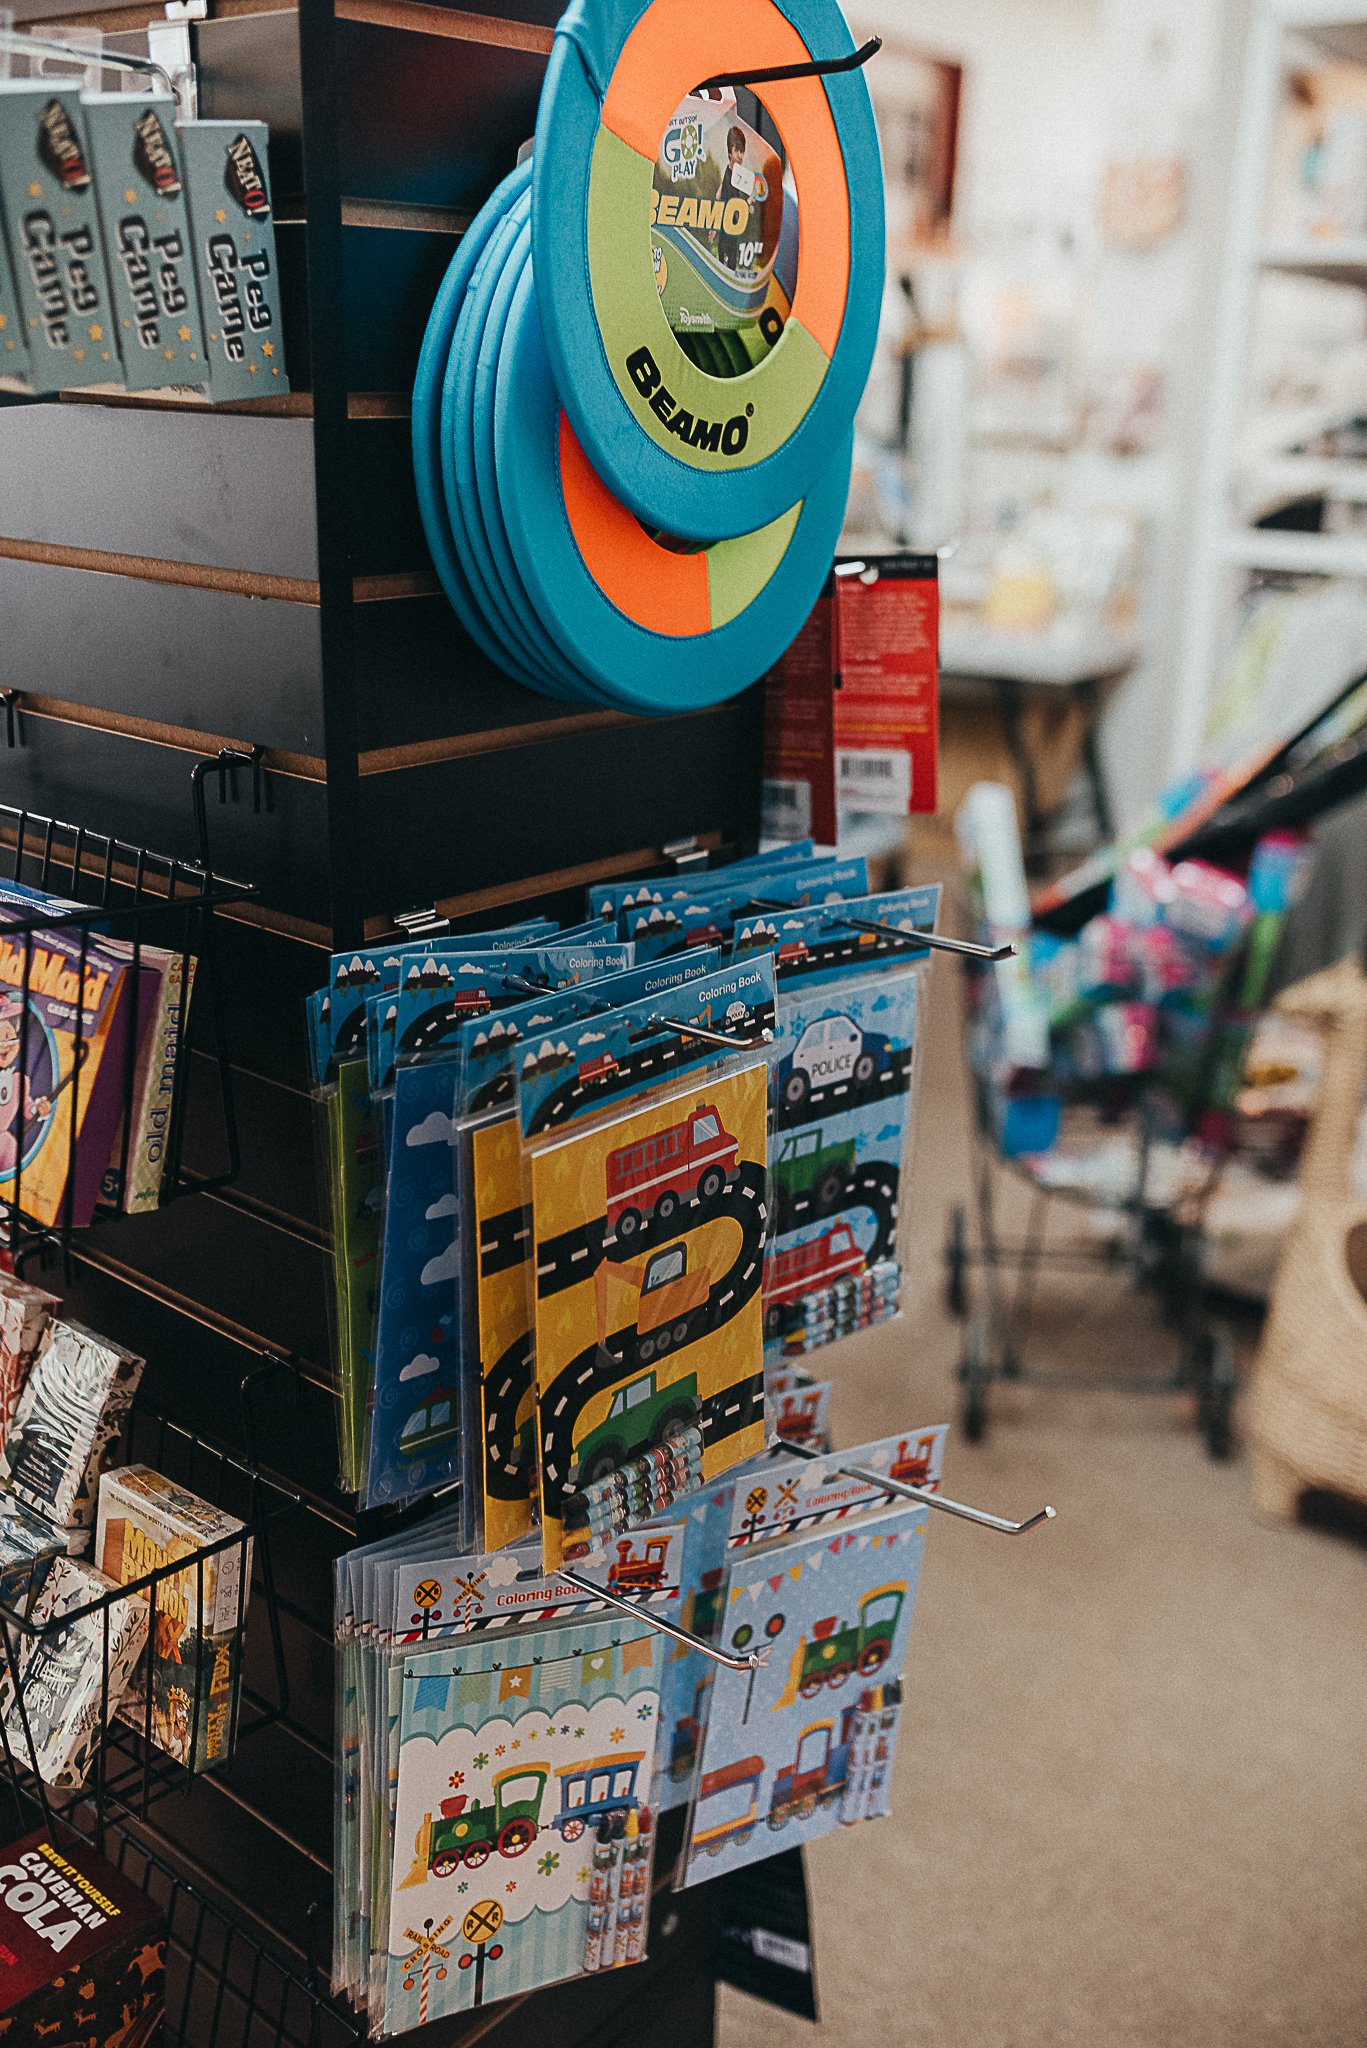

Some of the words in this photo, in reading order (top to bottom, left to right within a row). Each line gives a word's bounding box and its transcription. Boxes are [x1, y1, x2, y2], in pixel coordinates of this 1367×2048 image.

[664, 124, 703, 163] GO!
[673, 160, 696, 179] PLAY
[18, 208, 71, 350] Game
[59, 223, 100, 316] Peg
[117, 214, 162, 350] Game
[152, 228, 189, 318] Peg
[206, 233, 245, 364] Game
[238, 248, 273, 334] Peg
[679, 307, 711, 327] Toysmith
[0, 937, 27, 988] ld
[169, 974, 194, 985] GAE
[171, 962, 196, 973] CAD
[569, 957, 604, 969] Coloring
[605, 955, 626, 966] Book
[645, 972, 682, 991] Coloring
[684, 964, 706, 979] Book
[698, 983, 737, 1003] Coloring
[738, 971, 762, 989] Book
[147, 1106, 169, 1163] old
[159, 1003, 181, 1095] maid
[811, 1054, 852, 1079] POLICE
[120, 1553, 189, 1625] PYHON
[496, 1588, 553, 1607] Coloring
[555, 1584, 582, 1597] Boo
[23, 1678, 58, 1719] CARDS
[19, 1852, 107, 1930] CAVEMAN
[37, 1843, 68, 1868] BREW
[62, 1865, 78, 1876] IT
[72, 1874, 121, 1917] YOURSELF
[0, 1864, 82, 1953] COLA
[466, 1919, 474, 1930] R
[491, 1911, 499, 1922] R
[406, 1930, 423, 1945] RAIL
[430, 1943, 451, 1959] ROAD
